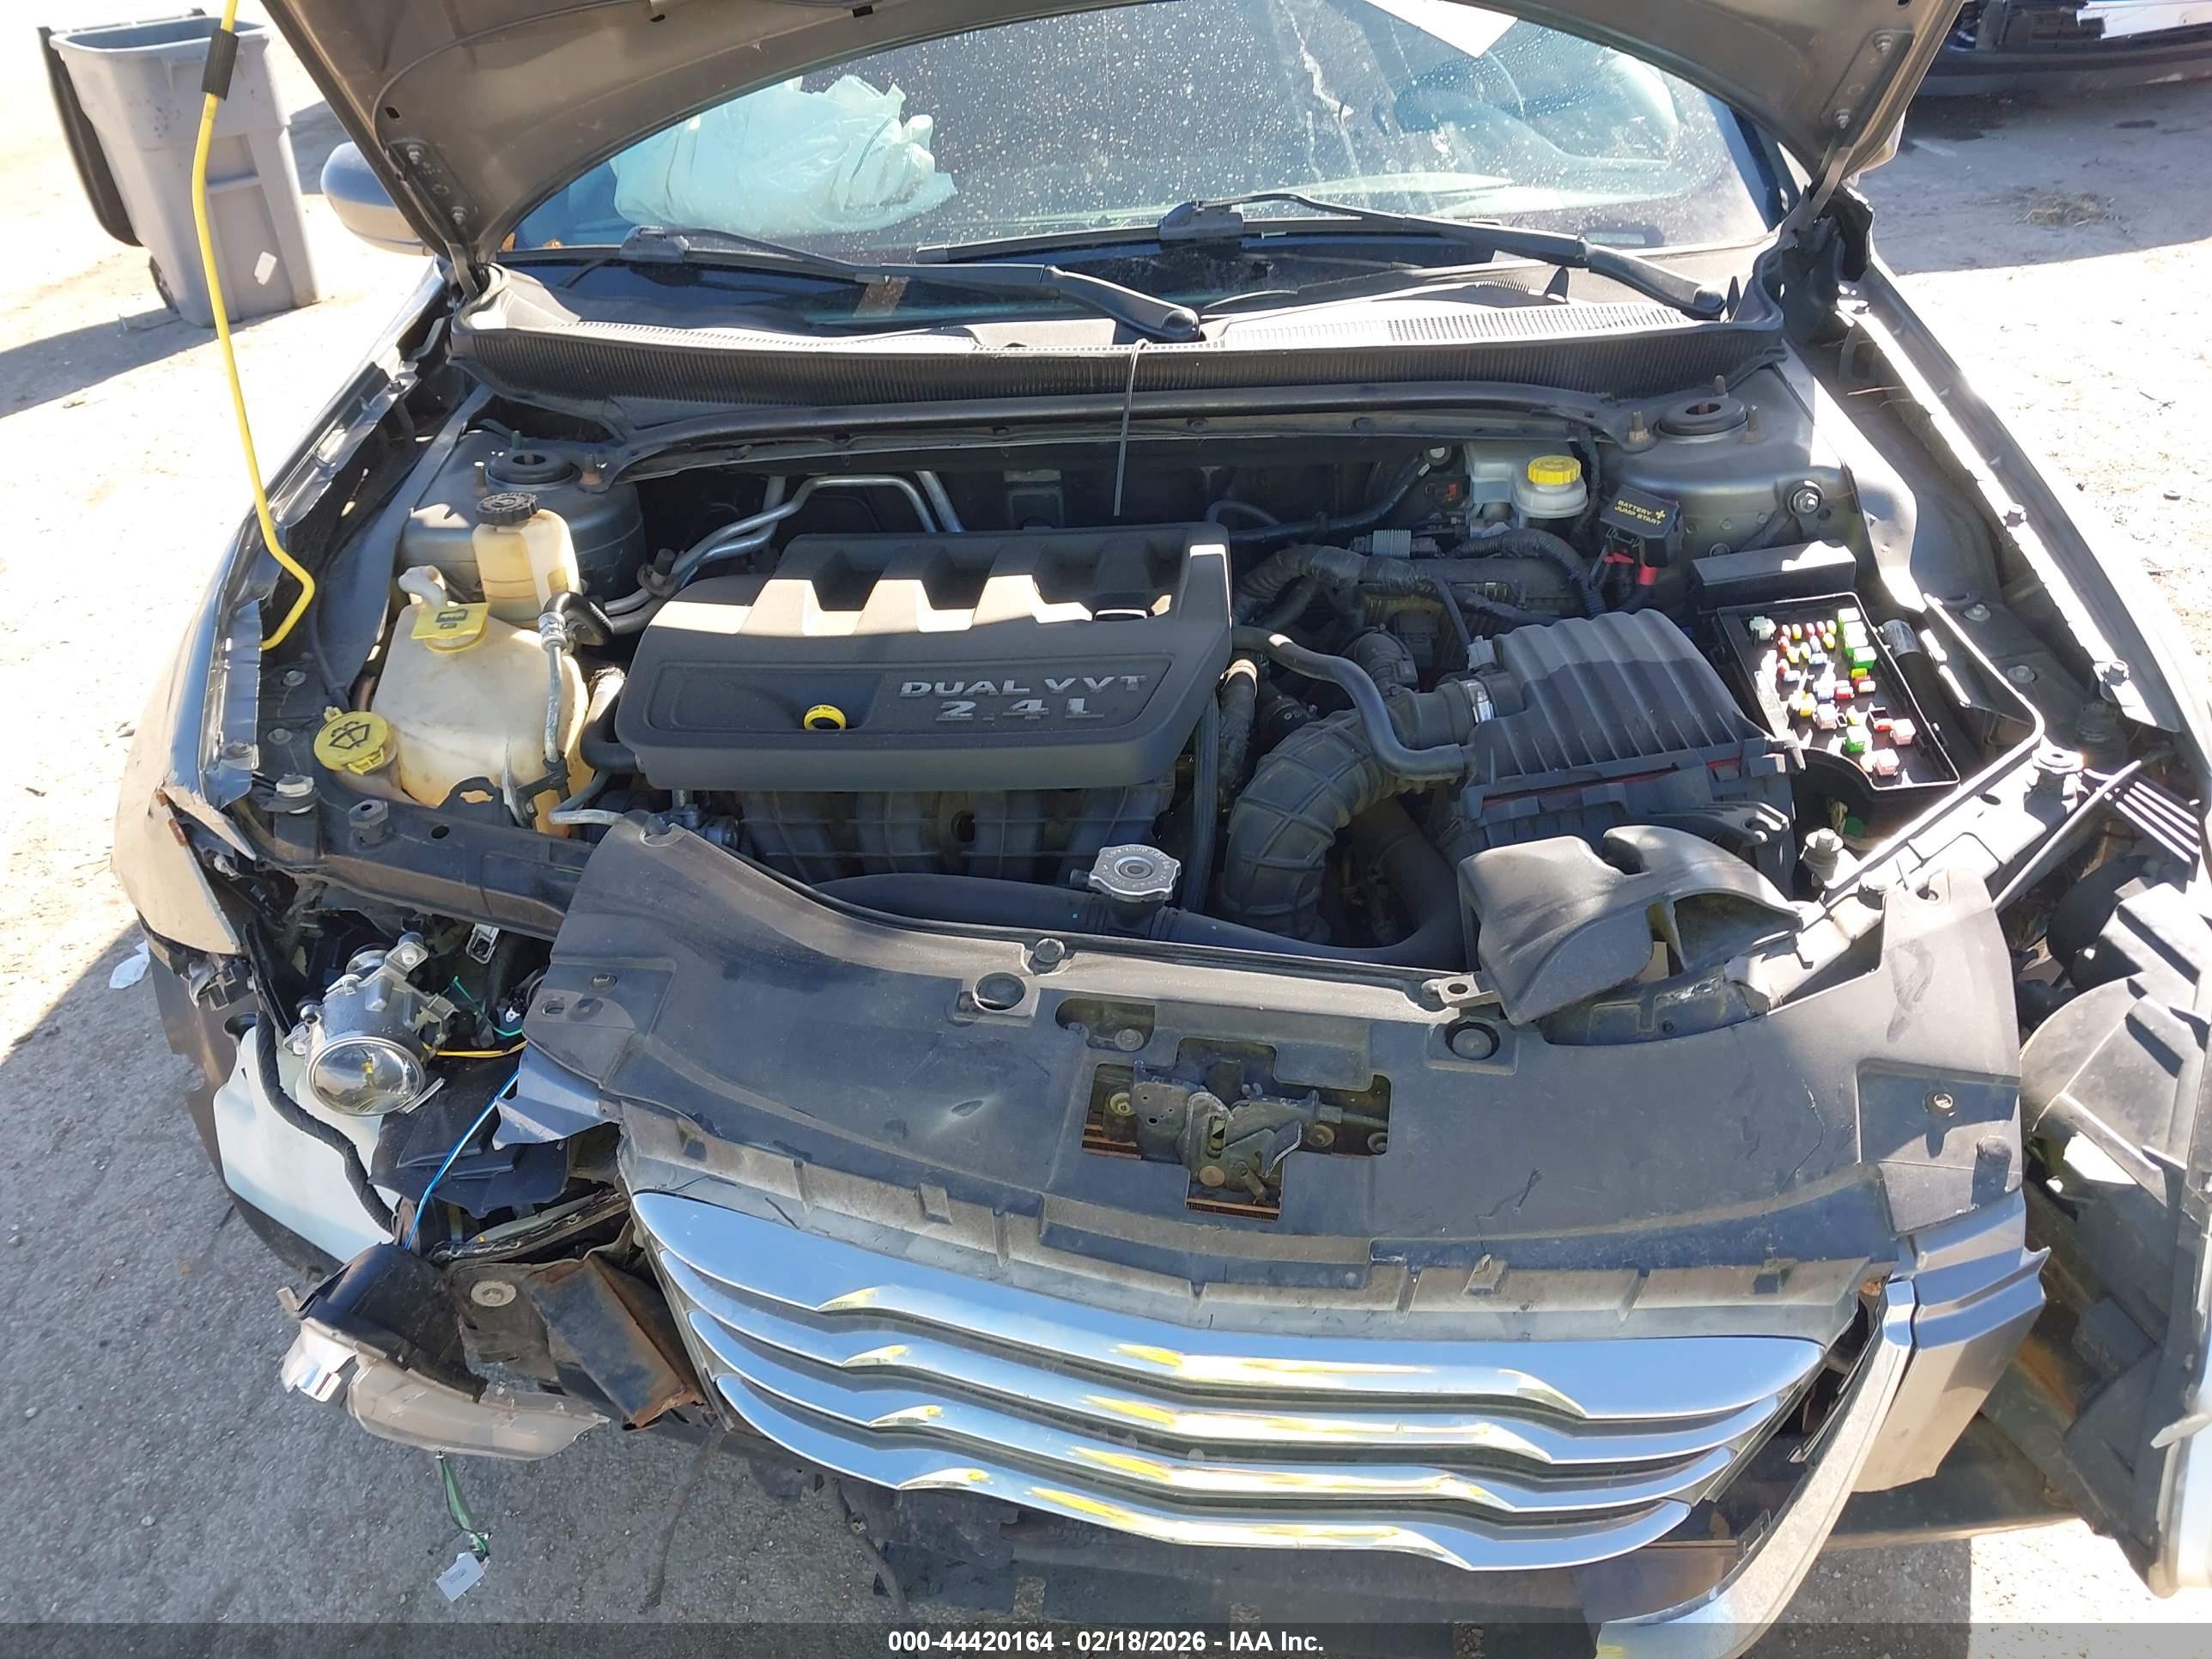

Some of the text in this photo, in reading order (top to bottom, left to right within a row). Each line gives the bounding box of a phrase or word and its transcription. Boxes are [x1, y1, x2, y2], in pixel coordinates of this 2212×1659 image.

[1614, 506, 1662, 526] JUMP START
[1616, 500, 1652, 516] BATTERY
[900, 679, 1030, 697] DUAL
